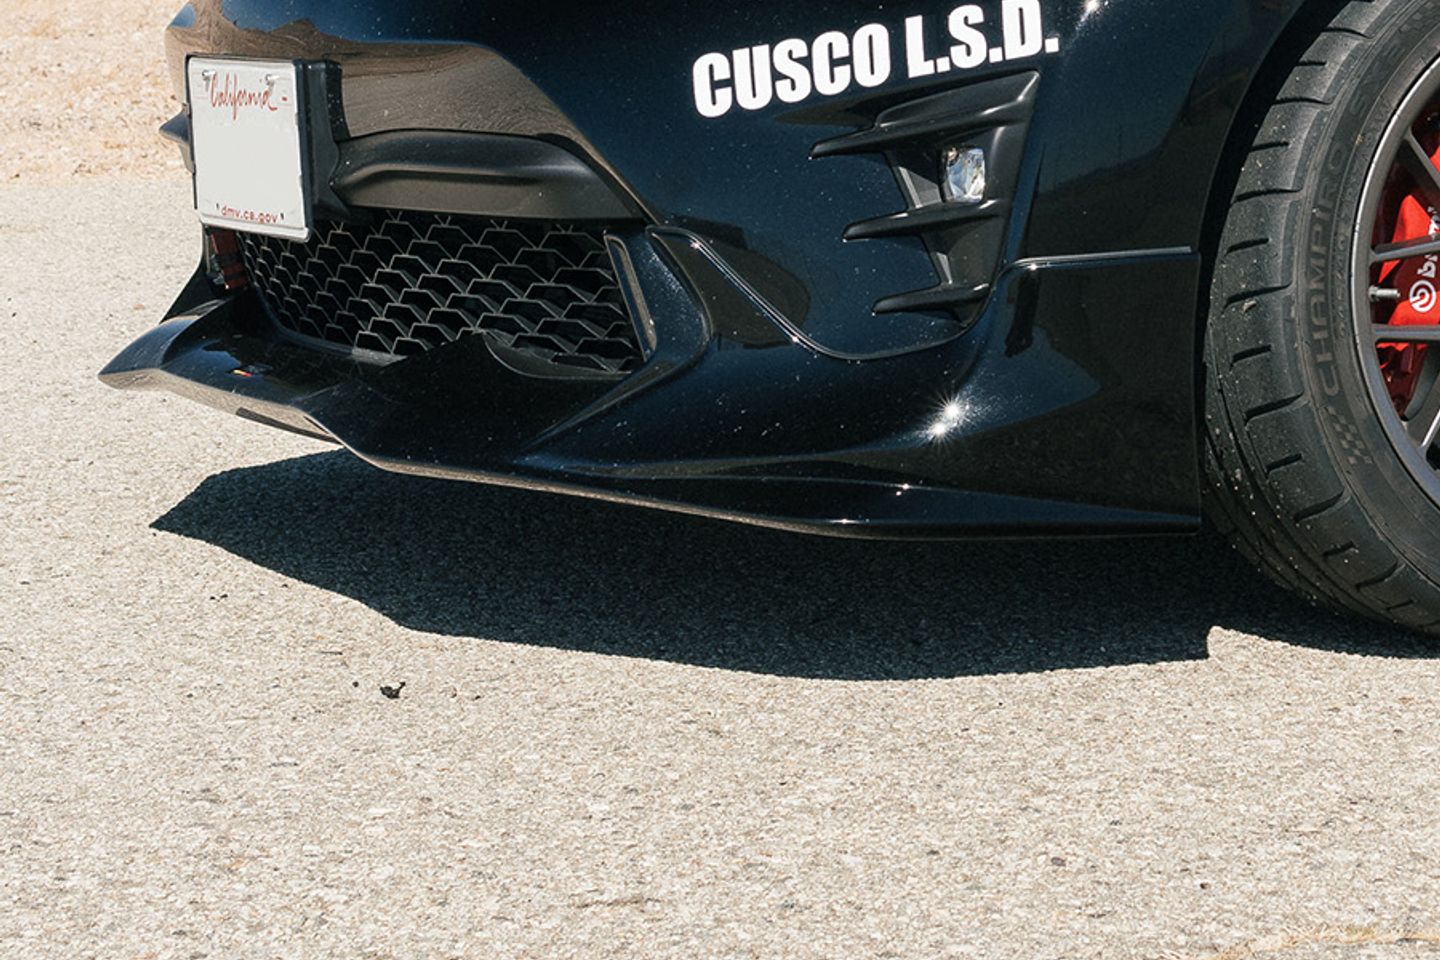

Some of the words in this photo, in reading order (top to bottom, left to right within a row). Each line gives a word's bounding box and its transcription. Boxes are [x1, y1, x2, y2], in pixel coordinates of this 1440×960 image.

[209, 71, 278, 121] California
[692, 23, 891, 119] CUSCO
[221, 205, 279, 224] dmv.ca.gov
[1309, 140, 1347, 397] CHAMPIRO
